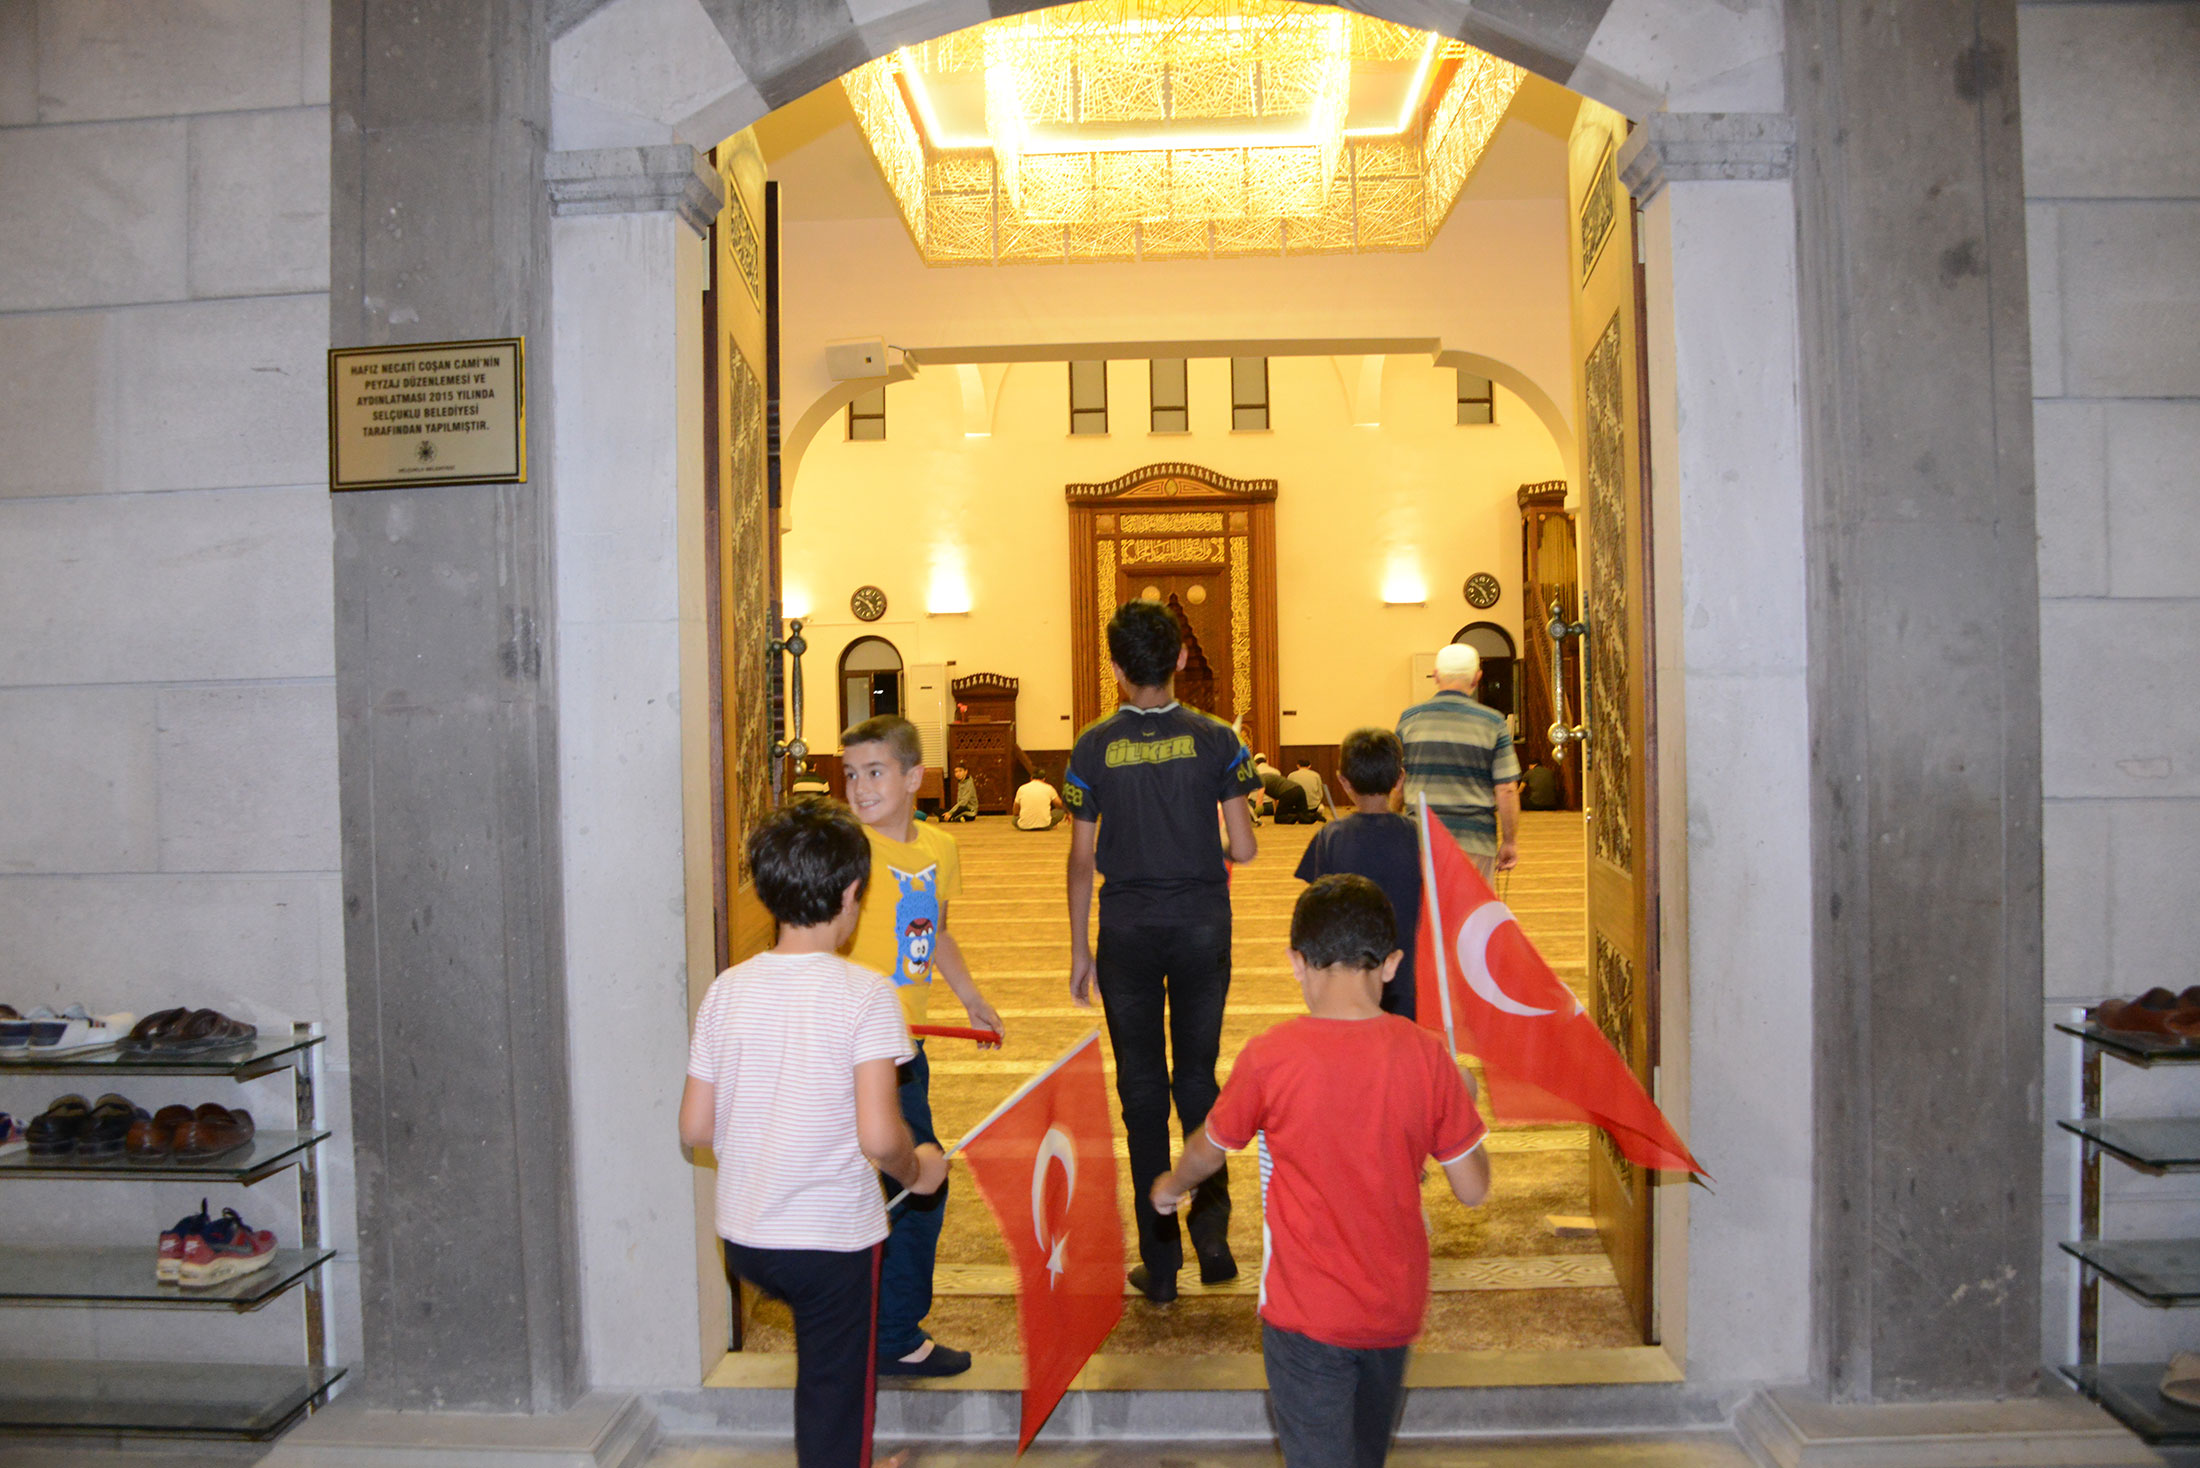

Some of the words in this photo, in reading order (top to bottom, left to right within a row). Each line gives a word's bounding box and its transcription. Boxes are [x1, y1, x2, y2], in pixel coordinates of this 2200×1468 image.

[351, 364, 378, 375] HAFIZ
[382, 361, 415, 373] NECATİ
[419, 360, 450, 372] COŞAN
[365, 379, 400, 390] PEYZAJ
[404, 374, 470, 388] DÜZENLEMESİ
[474, 374, 486, 383] VE
[357, 393, 426, 406] AYDINLATMASI
[429, 391, 453, 402] 2015
[458, 389, 495, 400] YILINDA
[373, 408, 420, 422] SELÇUKLU
[424, 403, 478, 417] BELEDİYESİ
[363, 424, 422, 437] TARAFINDAN
[425, 421, 489, 434] YAPILMIŞTIR.
[1106, 736, 1197, 767] ÜLKER
